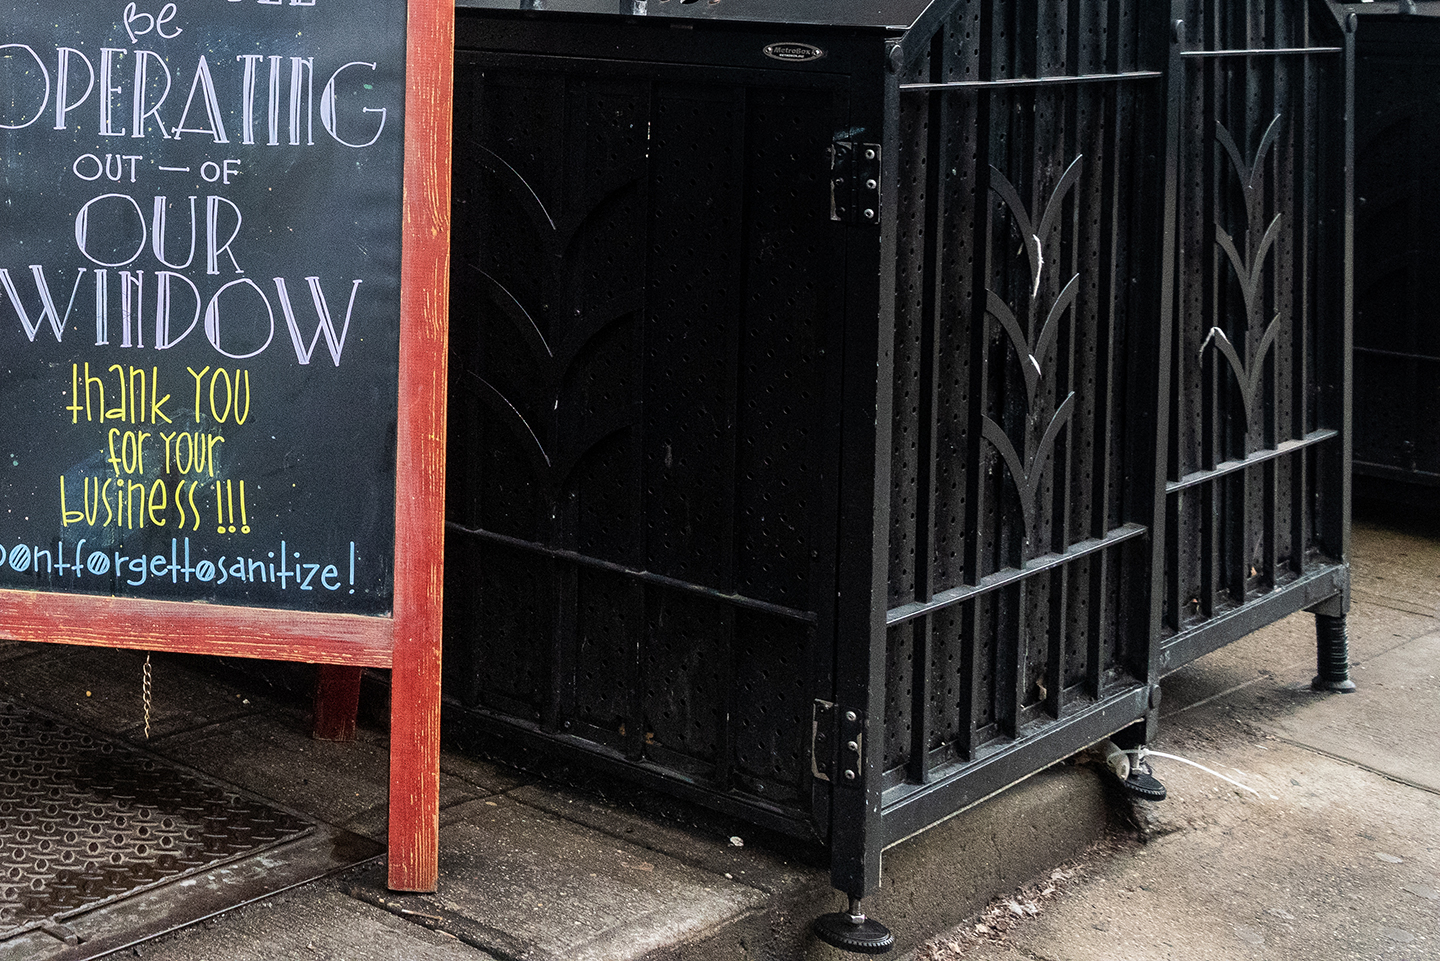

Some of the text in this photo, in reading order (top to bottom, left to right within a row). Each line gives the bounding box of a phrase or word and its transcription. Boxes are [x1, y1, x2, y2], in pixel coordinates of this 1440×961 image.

[72, 153, 242, 184] OUT OF
[75, 192, 244, 275] OUR
[66, 362, 172, 424] thank
[108, 428, 151, 477] for
